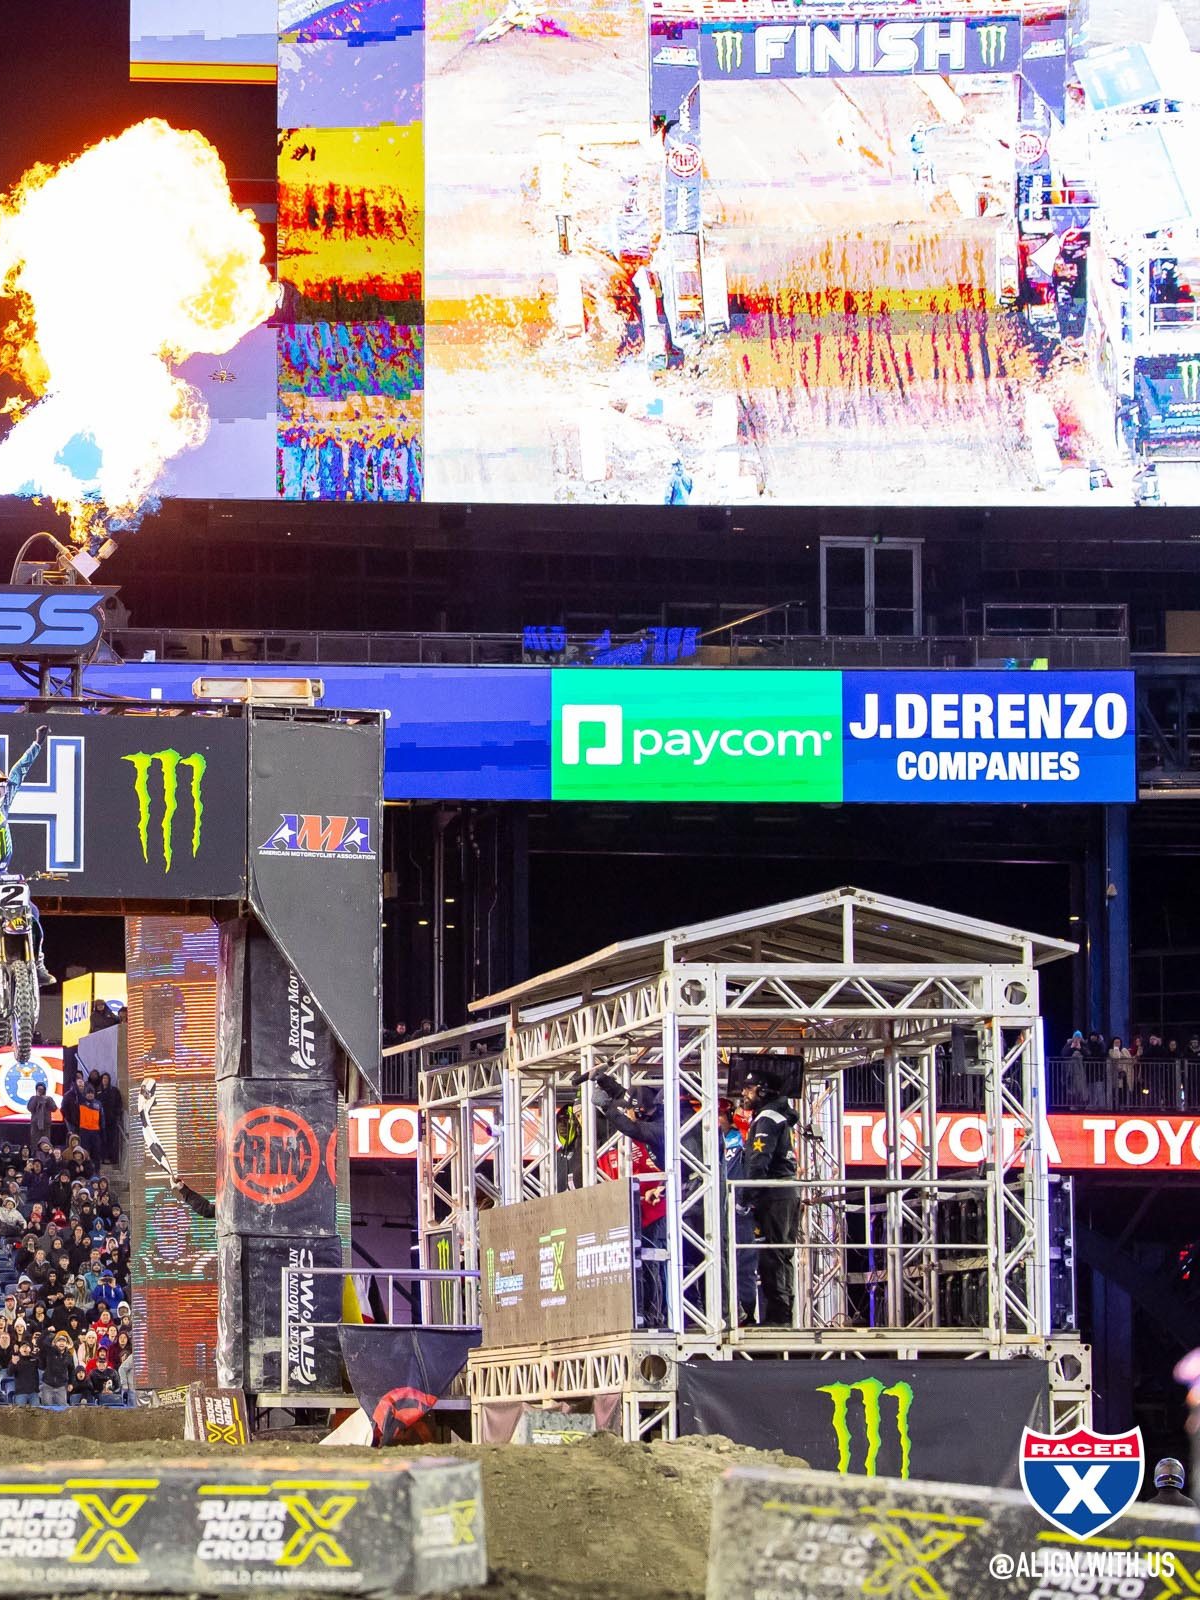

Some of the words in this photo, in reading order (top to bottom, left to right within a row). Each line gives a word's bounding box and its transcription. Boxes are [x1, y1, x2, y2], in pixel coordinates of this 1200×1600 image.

[754, 21, 967, 74] FINISH
[849, 692, 1129, 741] J.DERENZO
[632, 728, 824, 766] paycom
[897, 750, 1081, 782] COMPANIES
[257, 813, 377, 855] AMA
[258, 849, 291, 857] AMERICAN
[336, 853, 377, 861] ASSOCIATION
[0, 885, 25, 908] 2
[288, 1004, 300, 1049] ROCKY
[1083, 1119, 1199, 1166] TOY
[205, 1396, 217, 1425] CROSS
[213, 1397, 225, 1425] MOTO
[221, 1396, 233, 1426] SUPER
[198, 1500, 288, 1521] SUPER
[0, 1518, 77, 1539] MOTO
[202, 1519, 285, 1541] MOTO
[196, 1540, 285, 1561] CROSS
